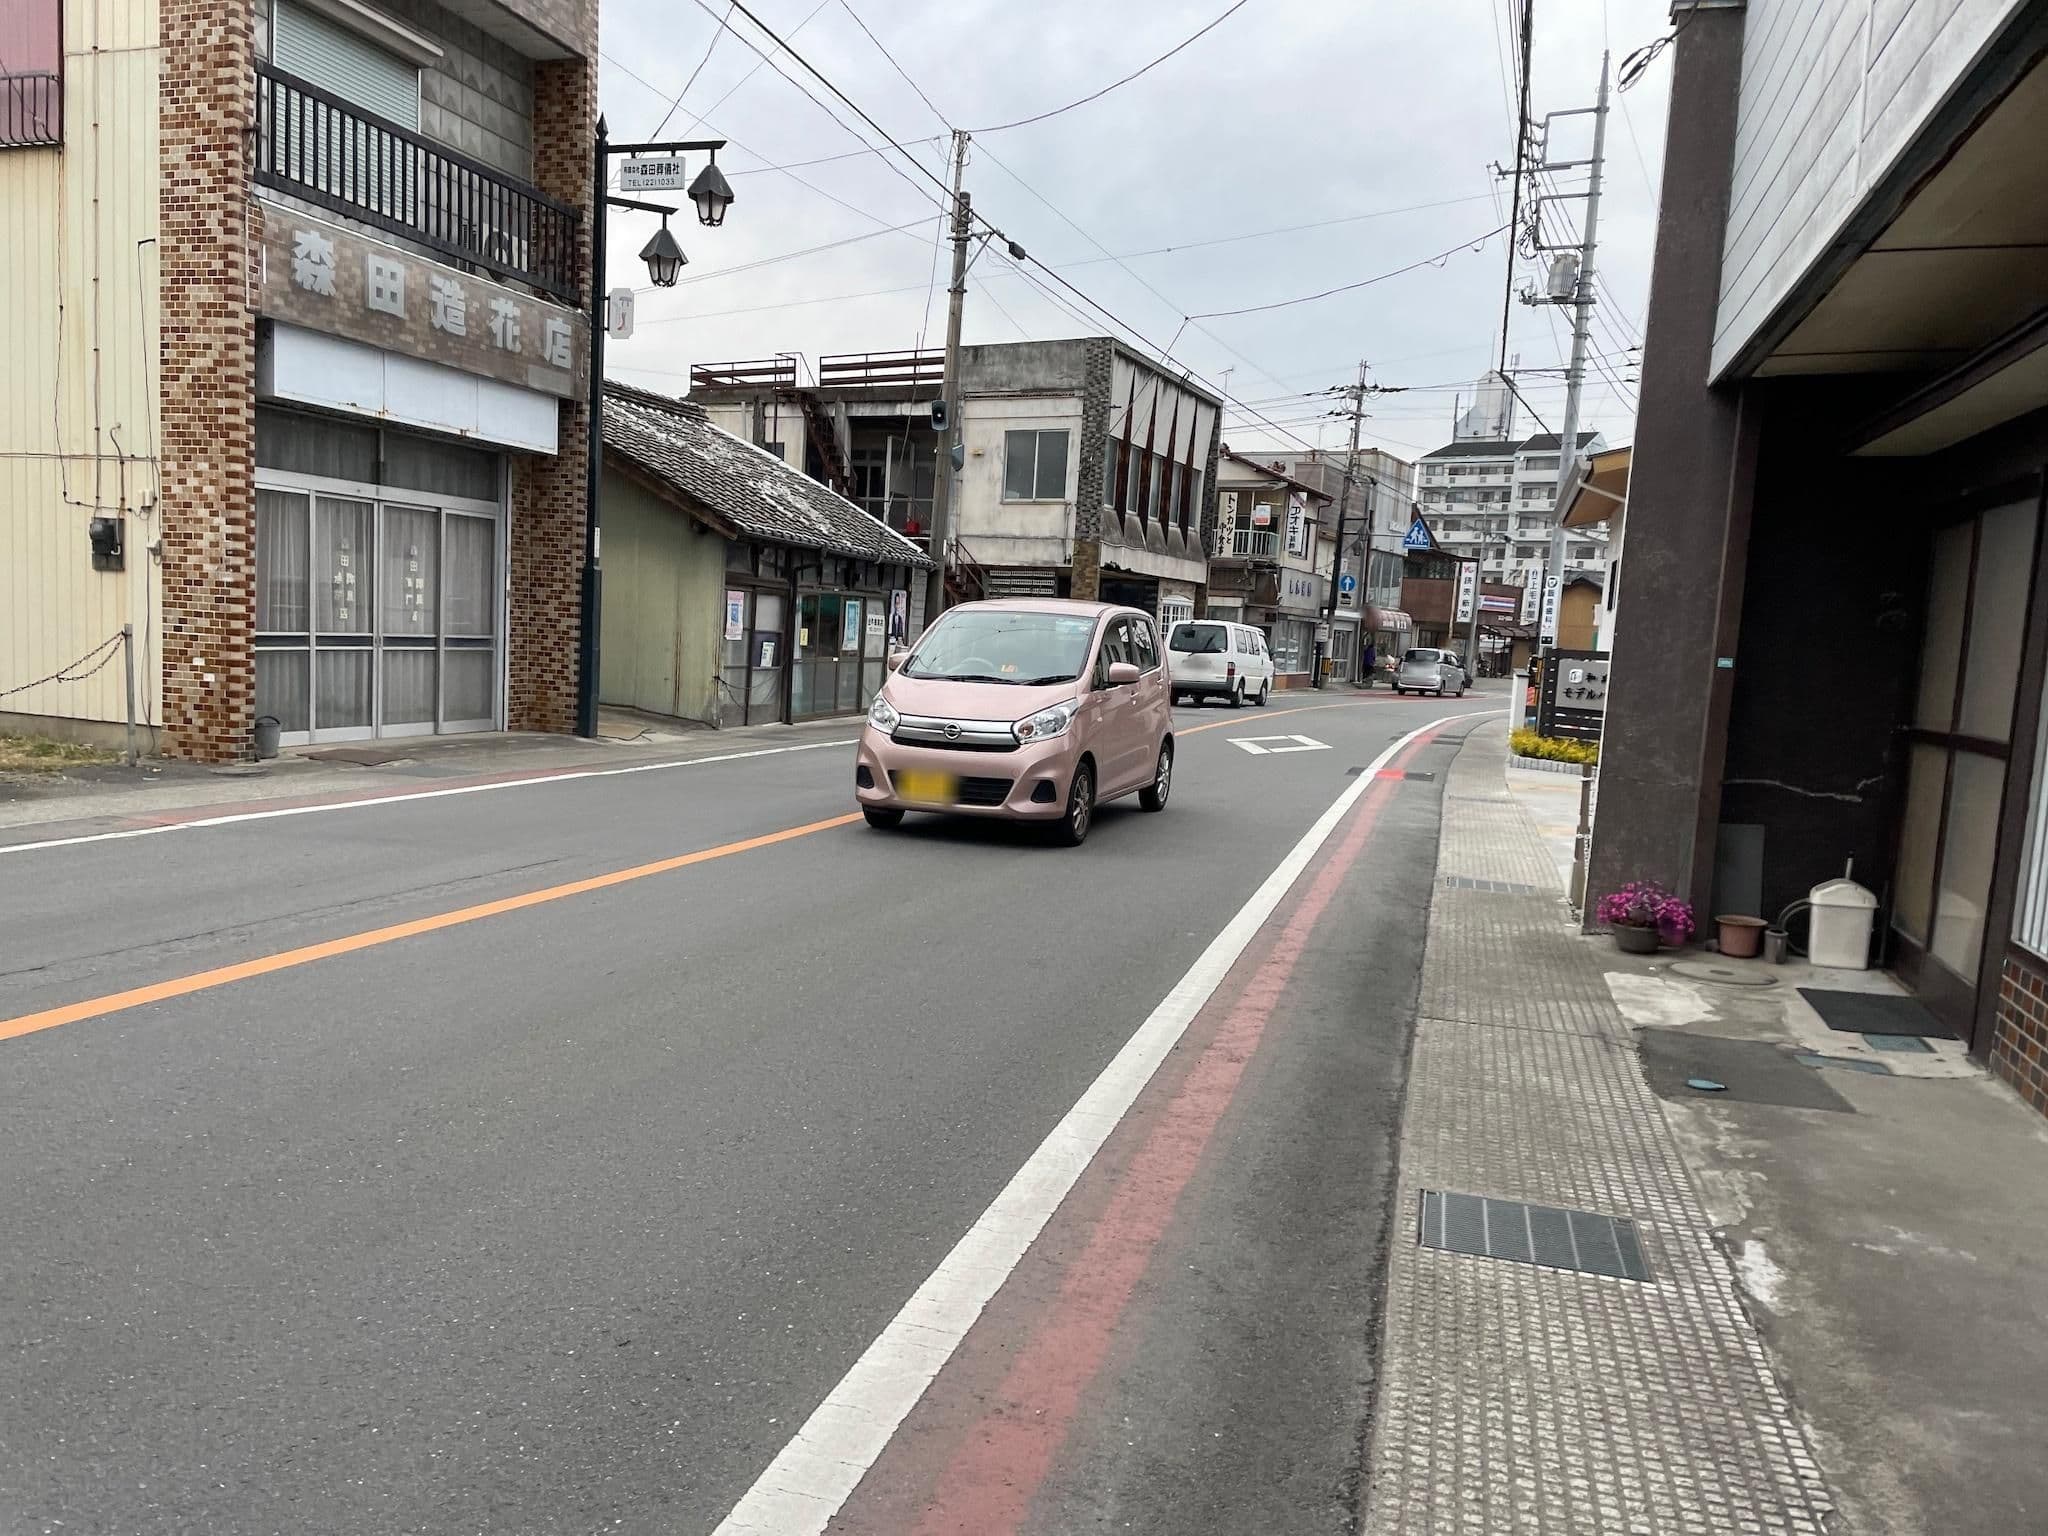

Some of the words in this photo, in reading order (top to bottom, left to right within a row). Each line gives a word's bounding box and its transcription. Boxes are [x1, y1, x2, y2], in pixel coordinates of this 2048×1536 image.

[291, 229, 572, 369] 森田造花店
[1225, 494, 1236, 545] トンカツと
